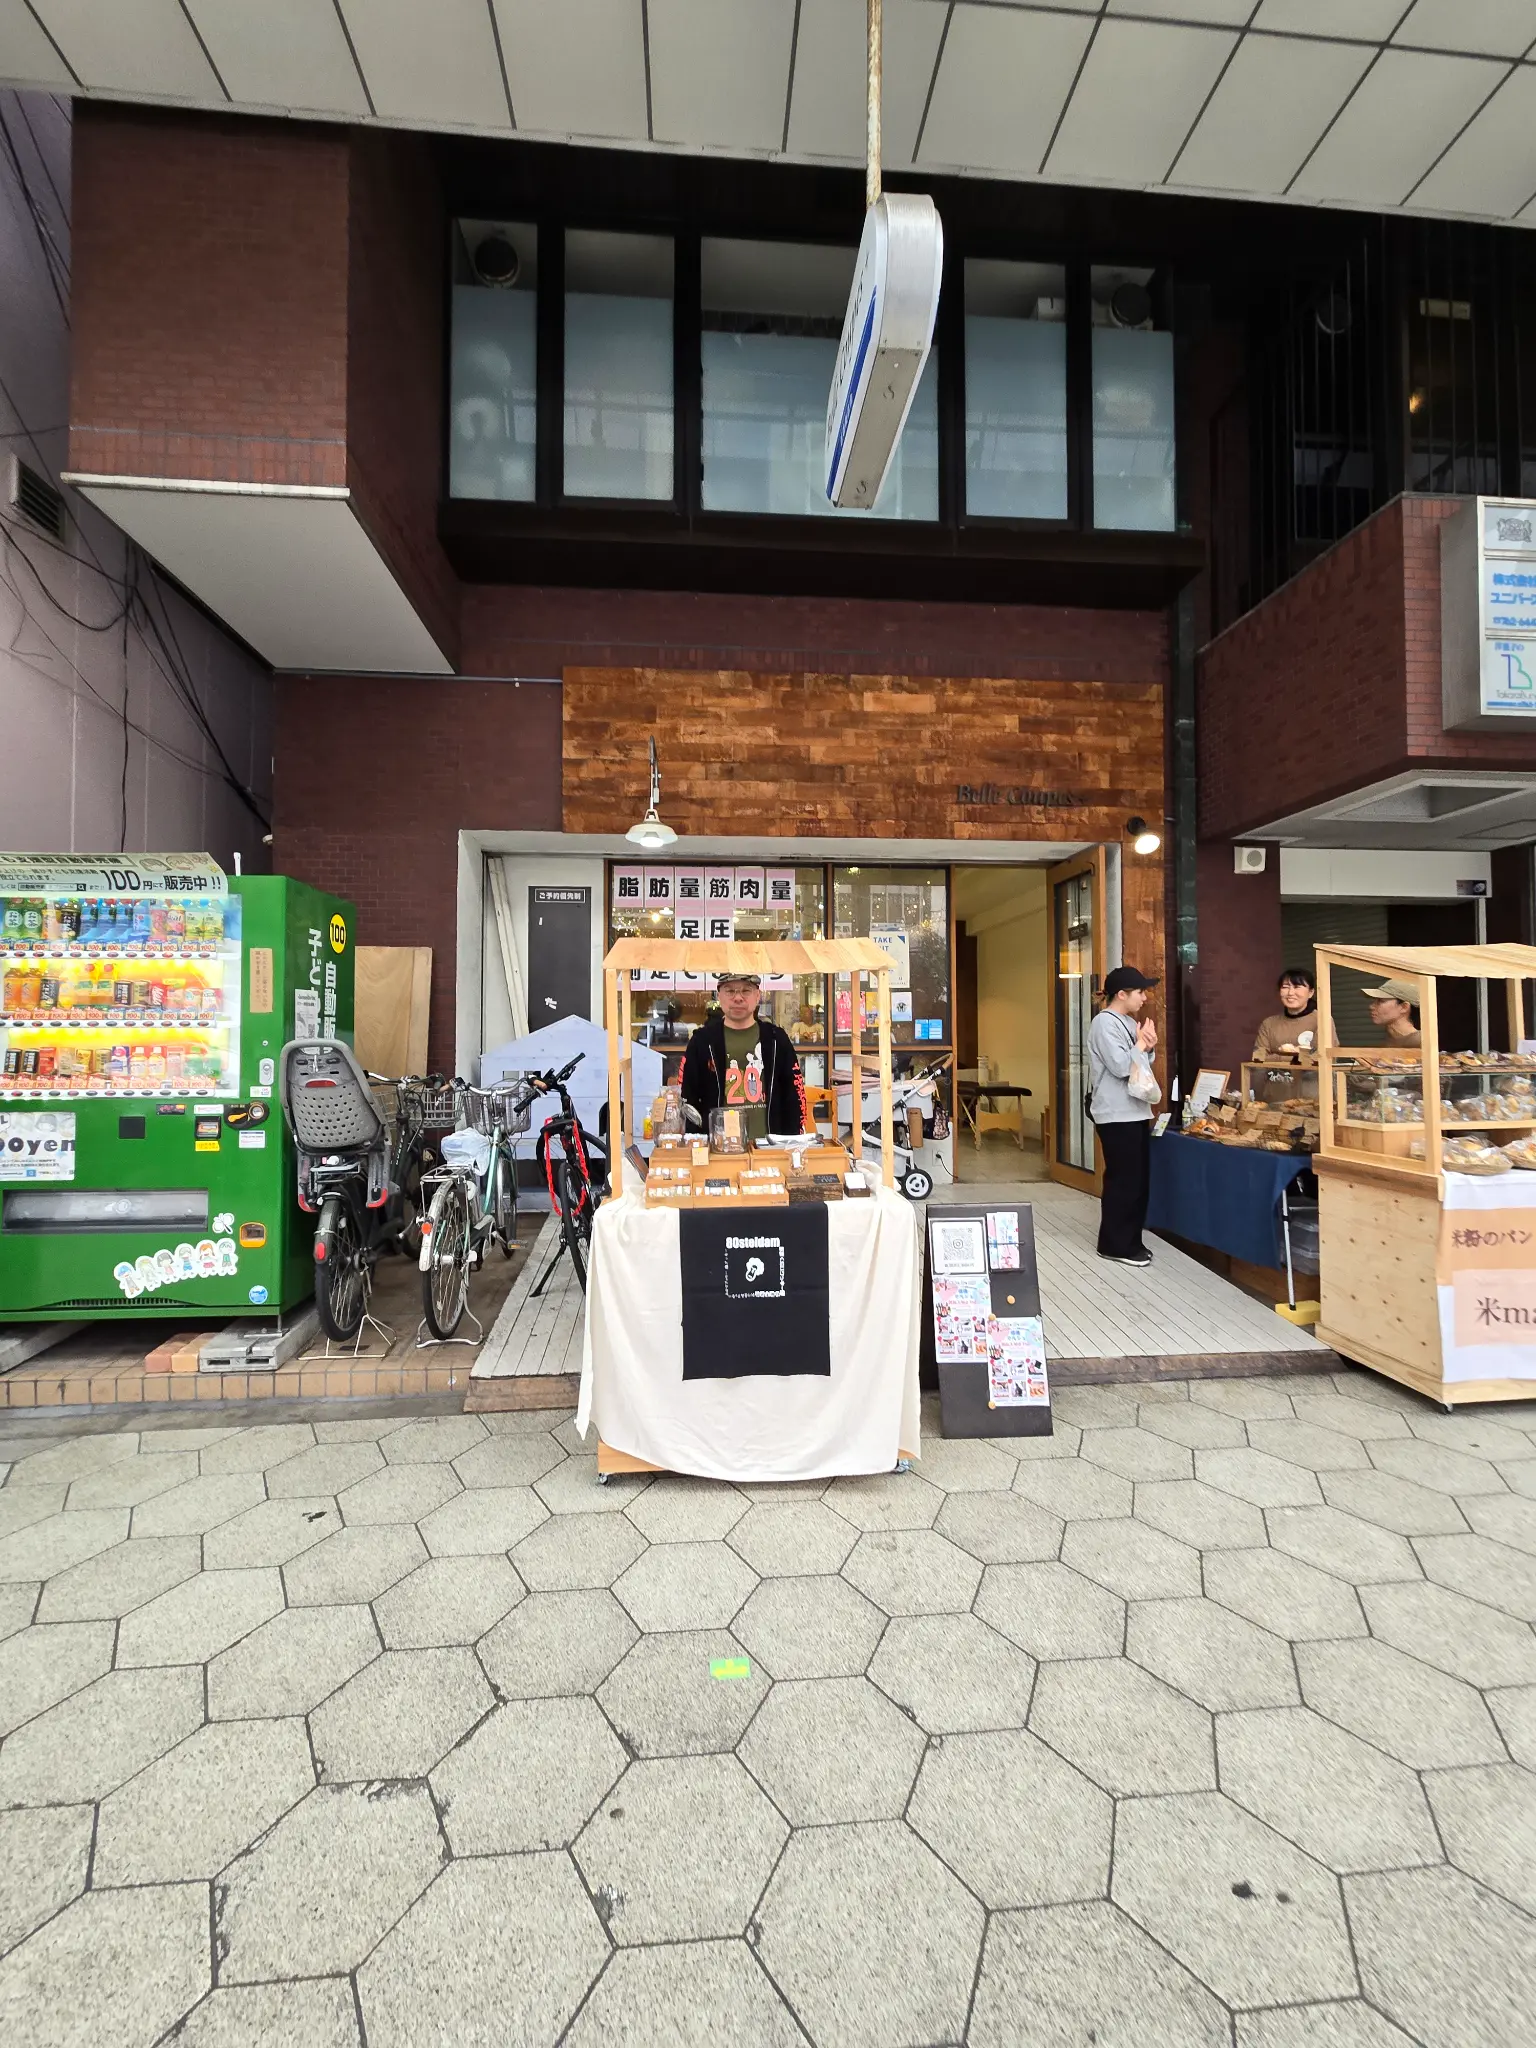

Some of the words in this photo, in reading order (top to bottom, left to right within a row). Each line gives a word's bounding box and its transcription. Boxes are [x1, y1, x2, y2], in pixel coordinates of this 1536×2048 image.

[957, 782, 1000, 804] Belle
[618, 877, 792, 901] 脂肪量筋肉量
[8, 912, 18, 927] お茶
[28, 912, 38, 927] お茶
[680, 919, 730, 939] 足圧
[331, 923, 344, 944] 100
[725, 1067, 761, 1104] 20
[1451, 1228, 1533, 1248] 米粉のパン
[1474, 1297, 1536, 1326] 米m
